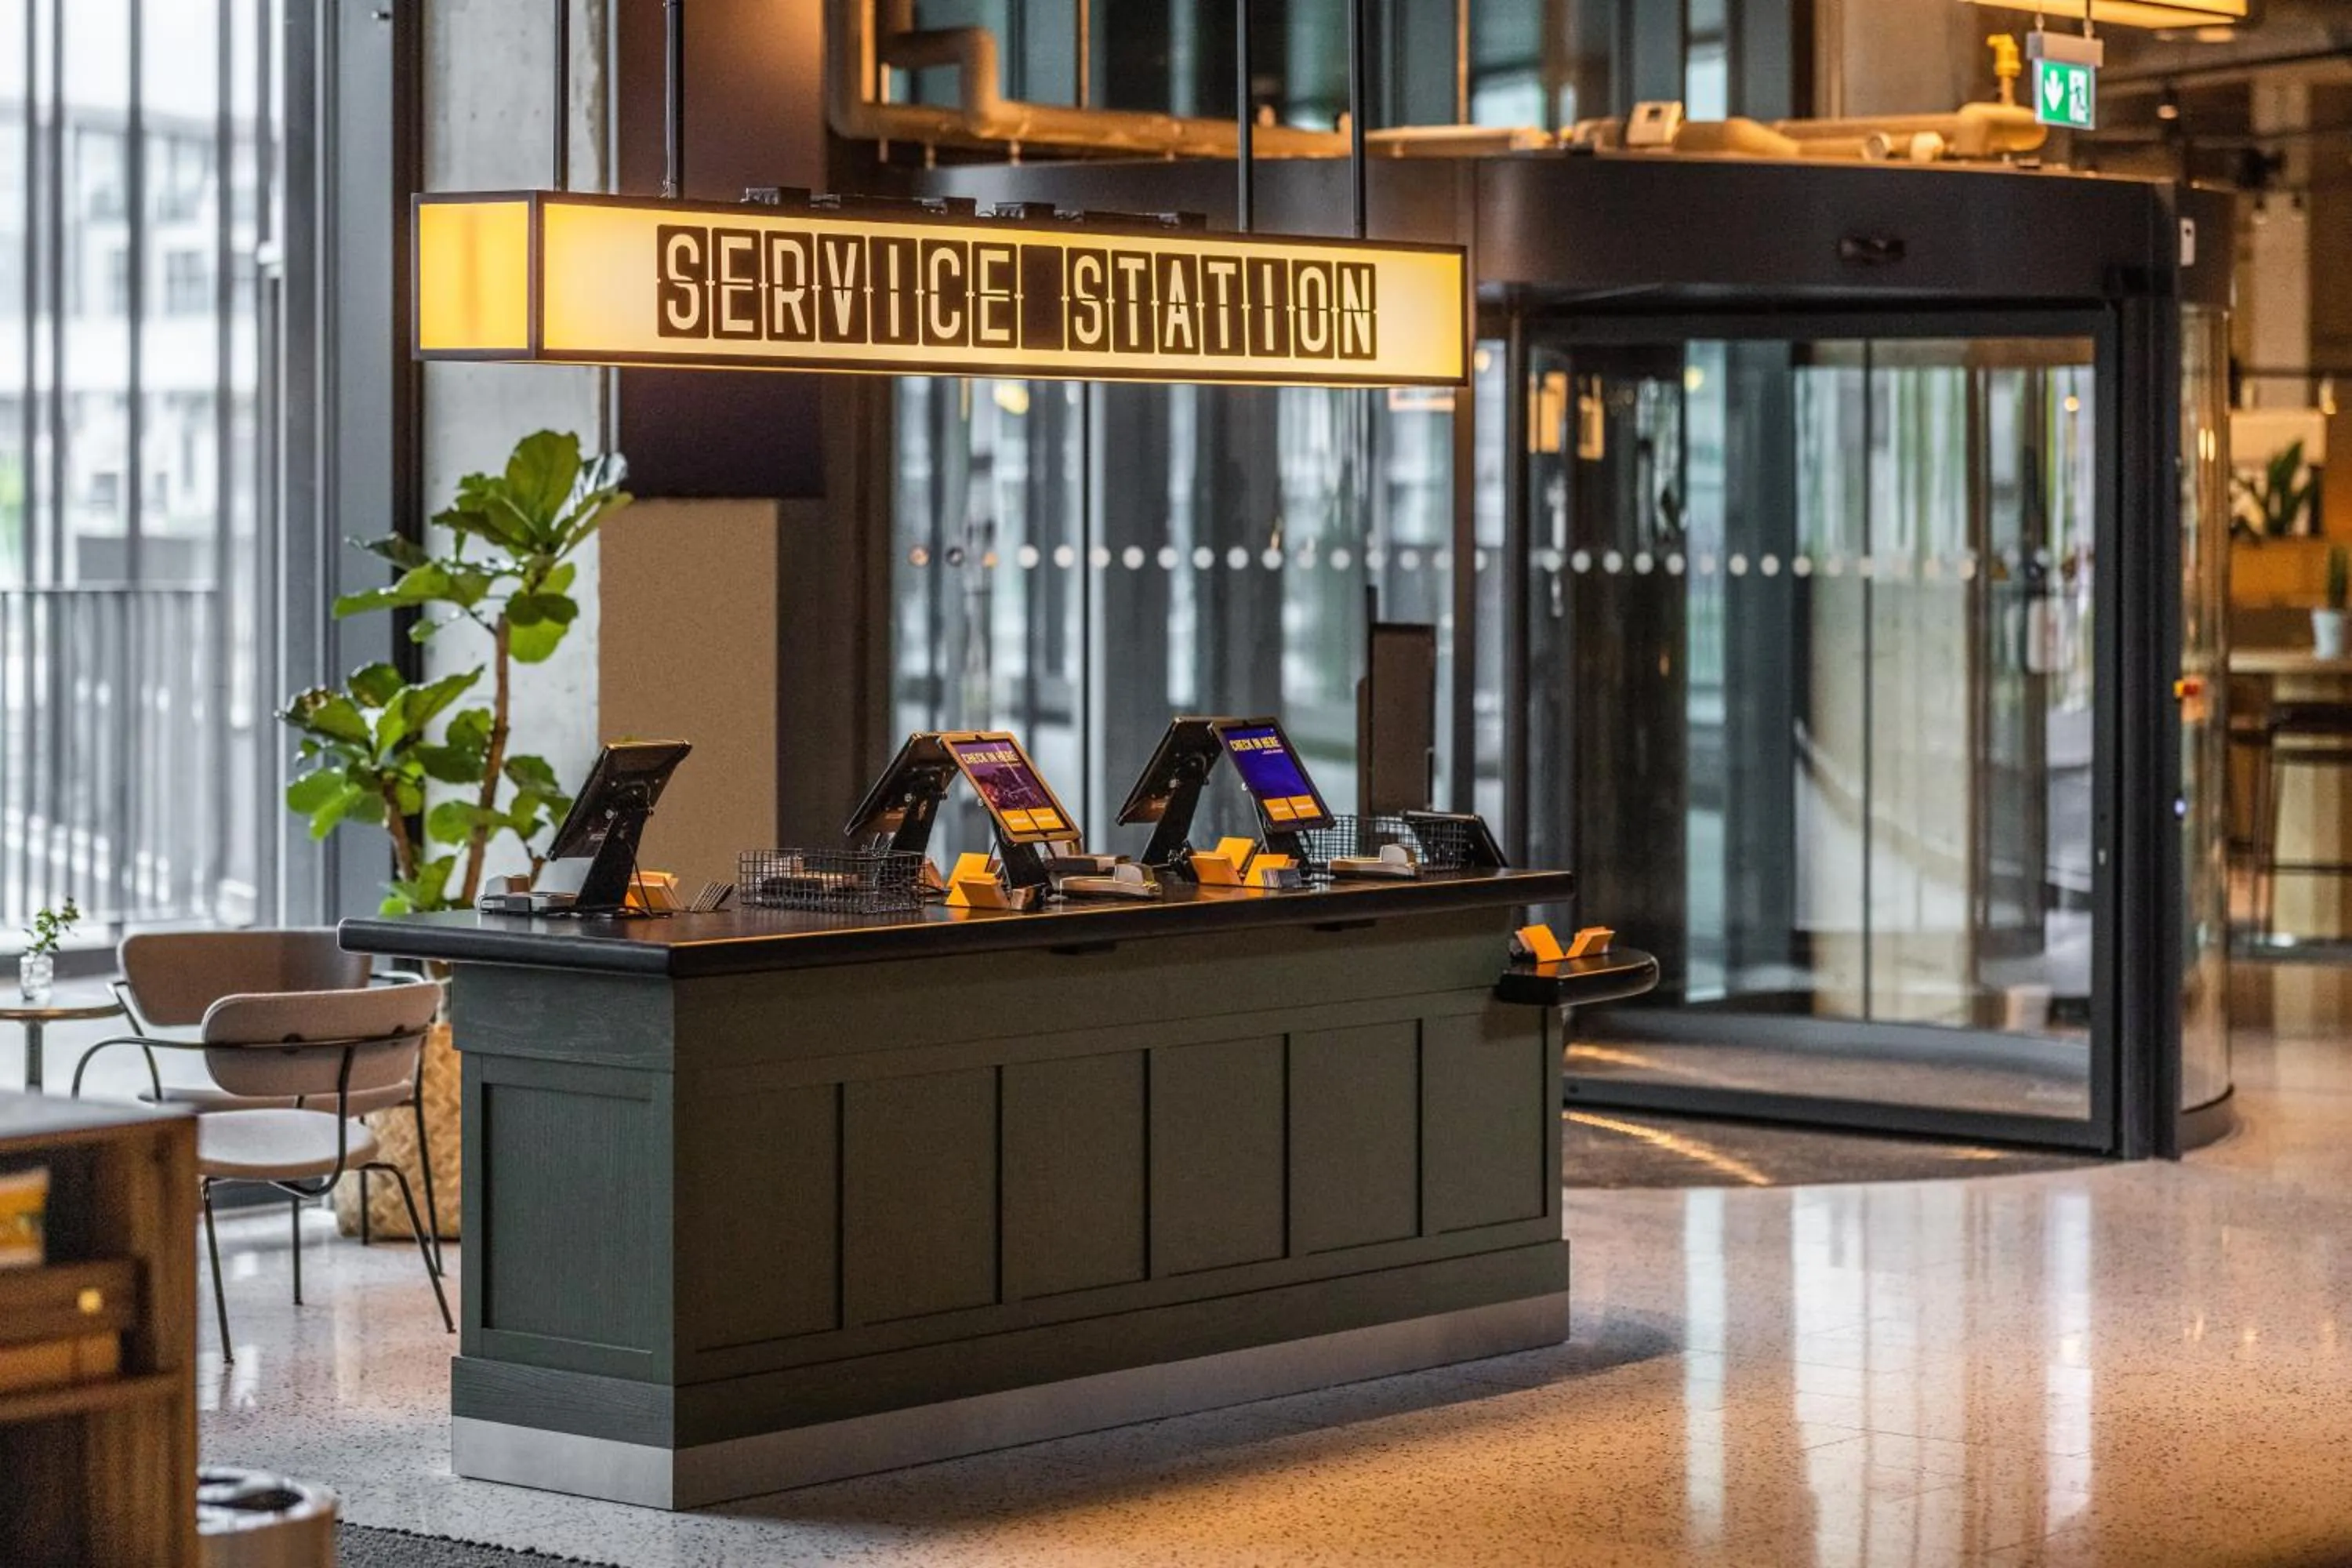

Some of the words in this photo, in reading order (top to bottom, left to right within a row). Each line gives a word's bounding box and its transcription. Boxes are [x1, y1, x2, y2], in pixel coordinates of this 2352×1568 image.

[666, 233, 1011, 341] SERVICE
[1073, 255, 1370, 355] STATION
[1229, 739, 1255, 751] CHECK
